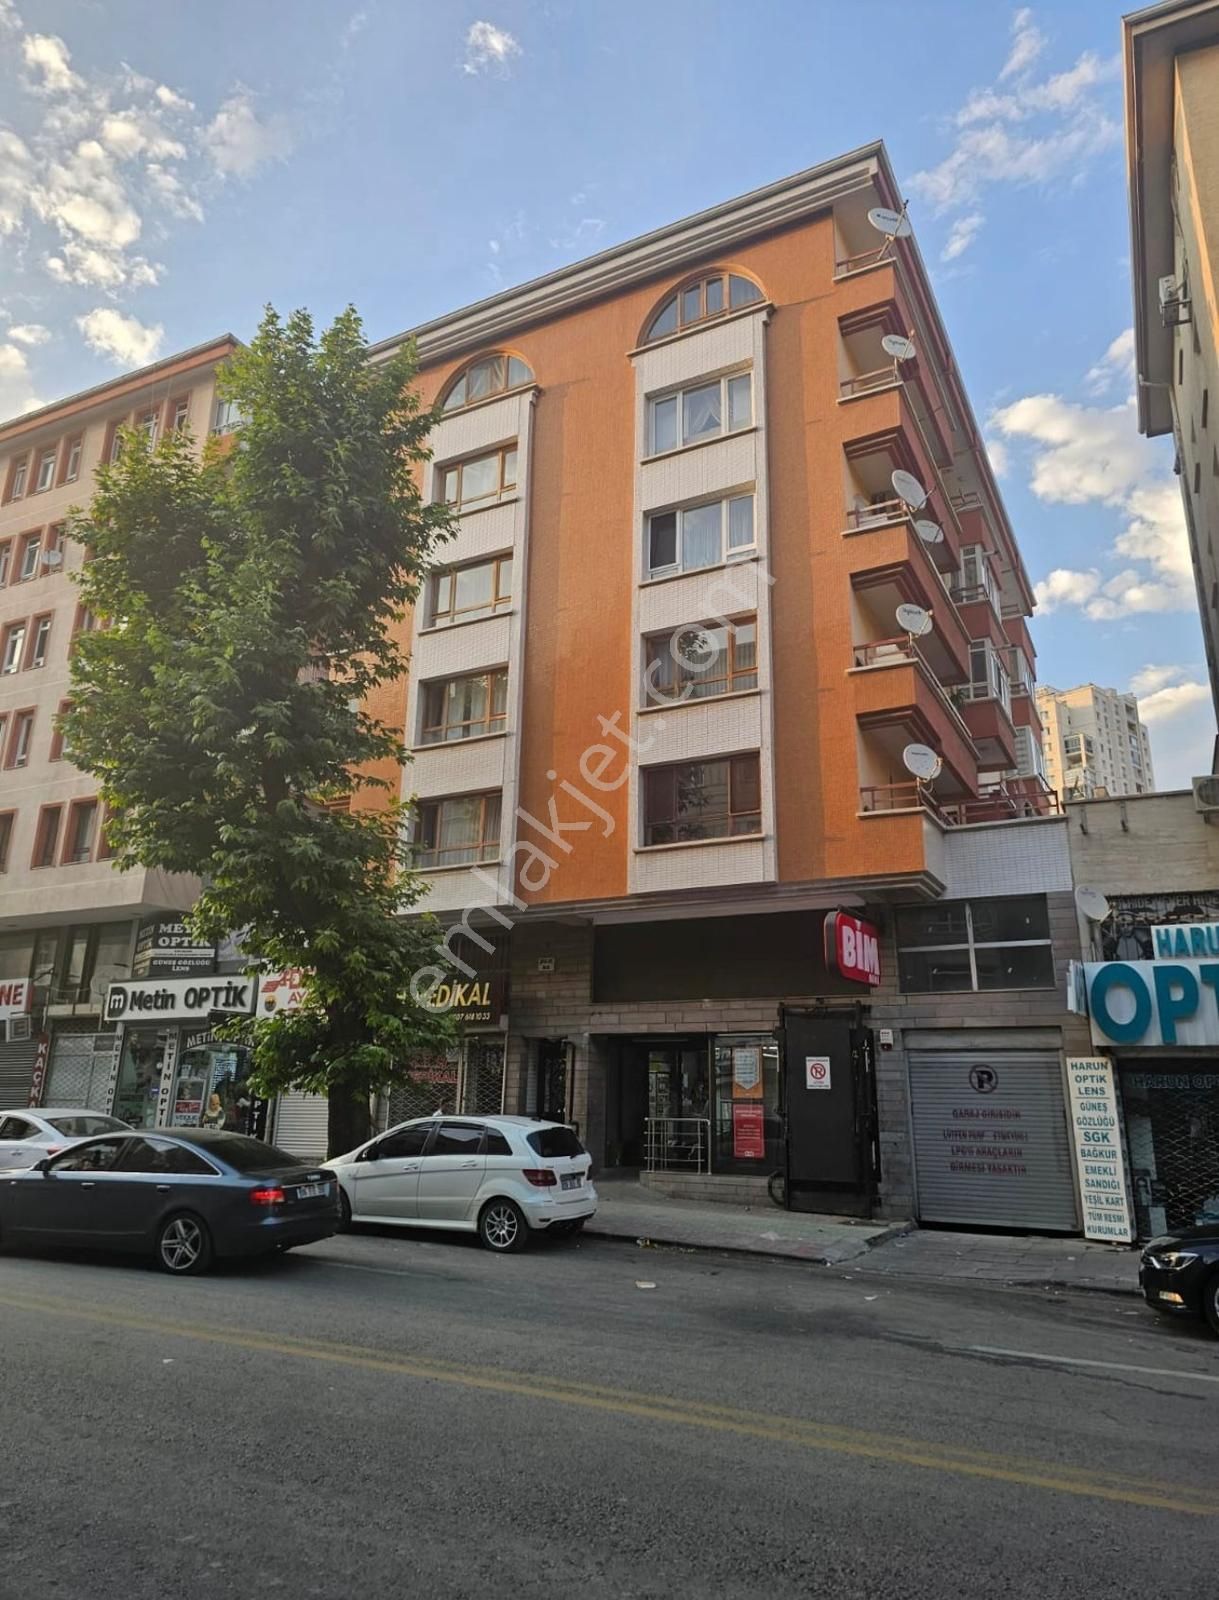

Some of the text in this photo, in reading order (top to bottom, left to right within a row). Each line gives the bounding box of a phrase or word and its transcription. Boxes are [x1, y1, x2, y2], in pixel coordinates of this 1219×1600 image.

[129, 988, 175, 1011] Metin
[184, 982, 249, 1009] OPTİK
[1070, 1062, 1108, 1070] HARUN
[1078, 1087, 1105, 1095] LENS
[1083, 1131, 1110, 1142] SGK
[1080, 1147, 1117, 1158] BAĞKUR
[1105, 1196, 1124, 1206] KART
[1086, 1225, 1128, 1236] KURUMLAR
